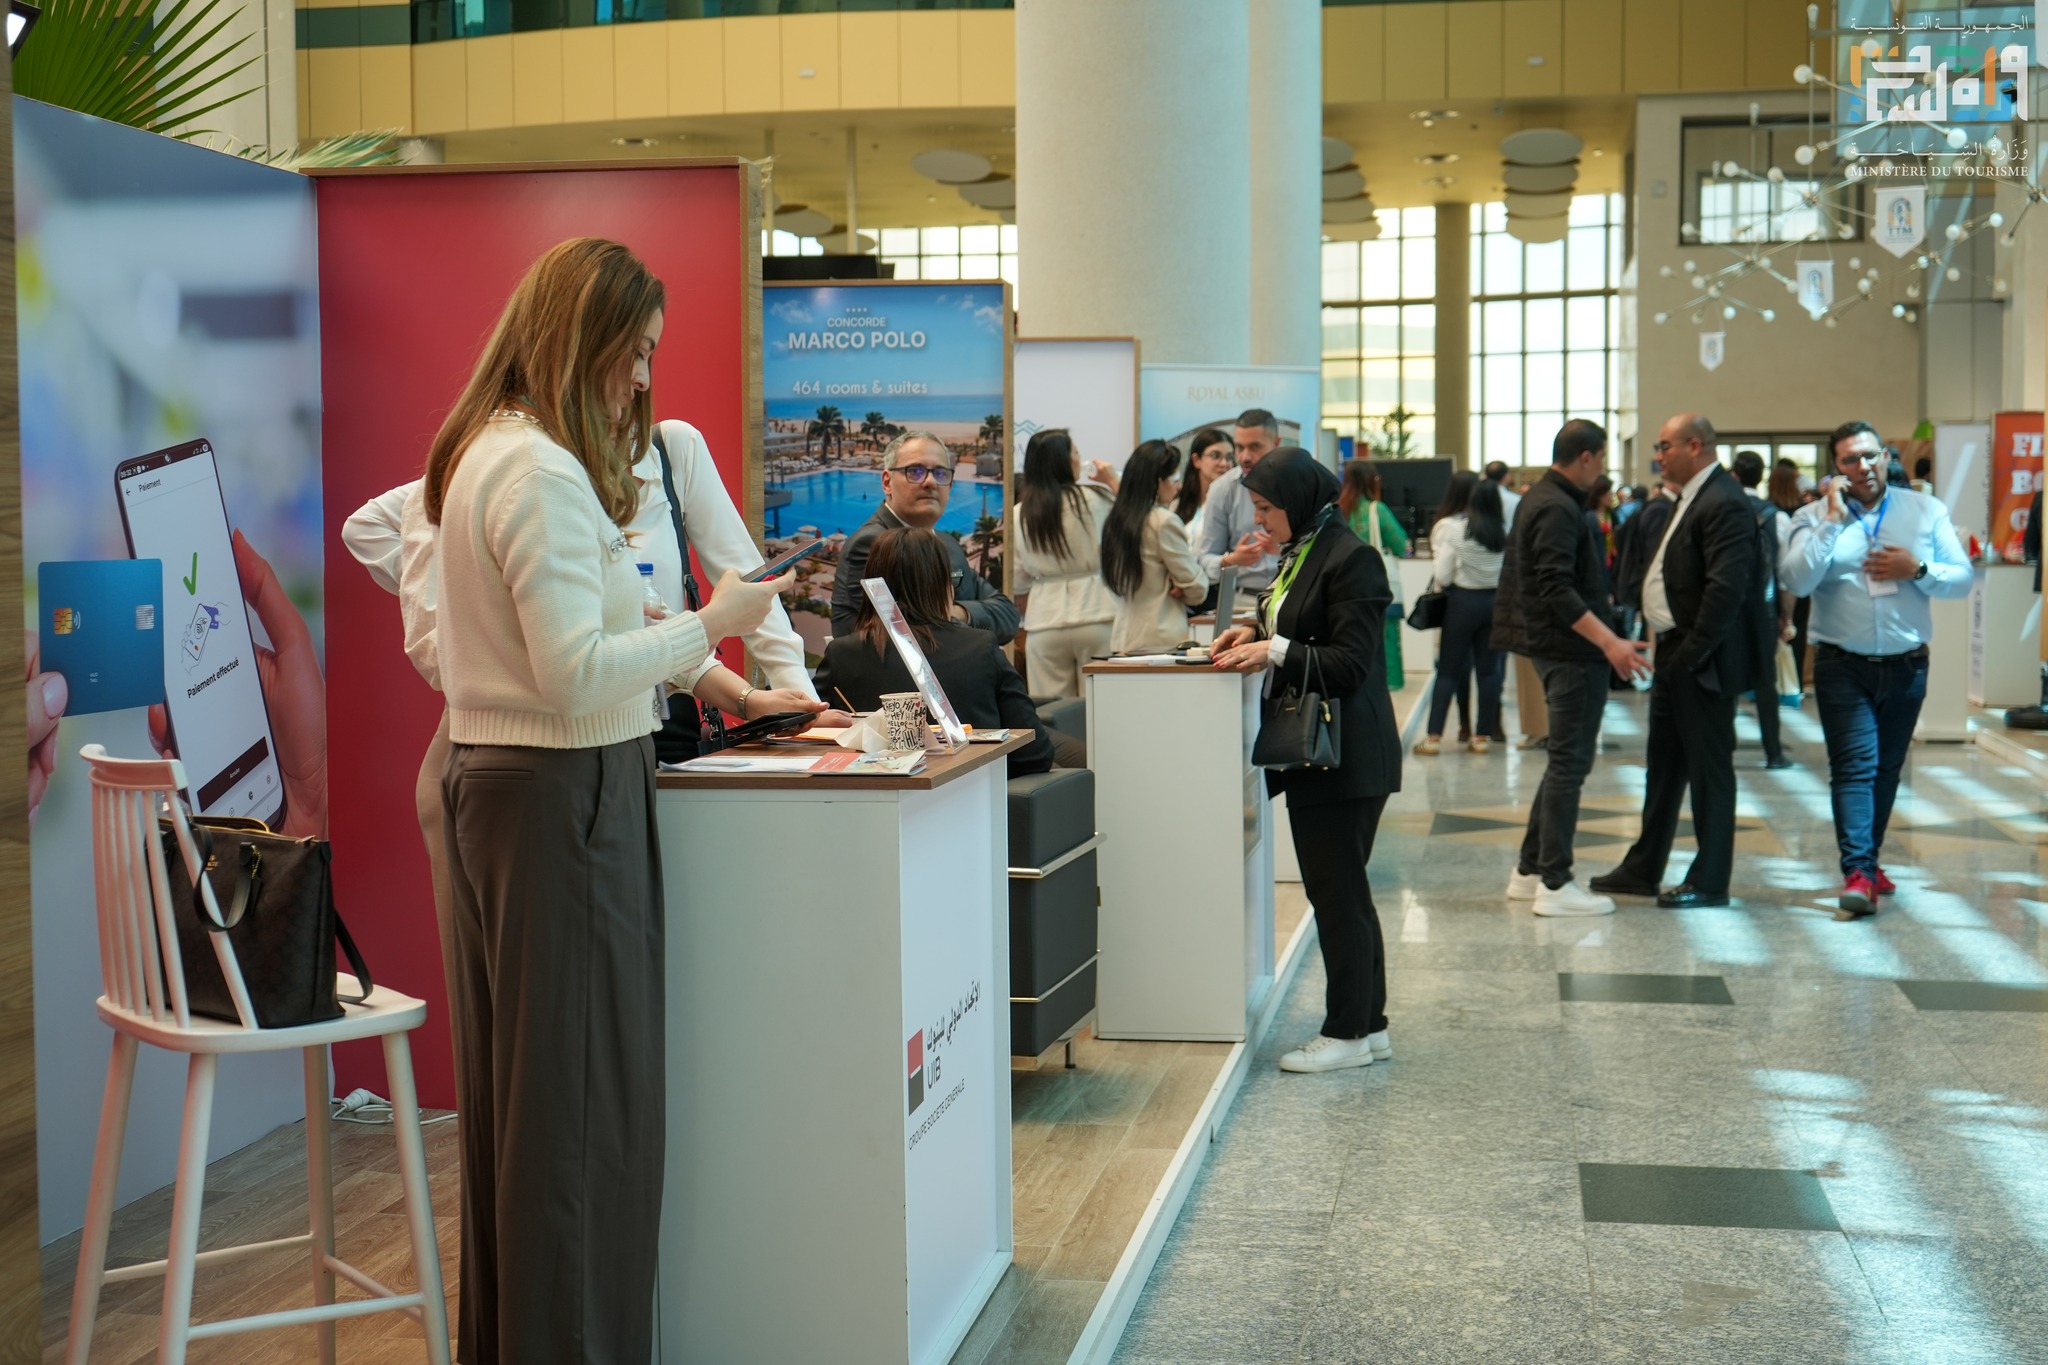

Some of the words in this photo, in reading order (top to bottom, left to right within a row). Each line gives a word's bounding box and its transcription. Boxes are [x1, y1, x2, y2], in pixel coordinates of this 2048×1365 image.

[826, 316, 886, 328] CONCORDE
[788, 331, 866, 349] MARCO
[870, 330, 927, 348] POLO
[792, 380, 820, 395] 464
[826, 381, 867, 395] rooms
[872, 380, 883, 394] &
[887, 380, 928, 394] suites
[1187, 385, 1229, 401] ROYAL
[138, 478, 162, 493] Paiement
[187, 673, 216, 699] Paiement
[216, 656, 239, 679] effectué
[926, 1055, 942, 1089] UIB
[908, 1120, 928, 1151] GROUPE
